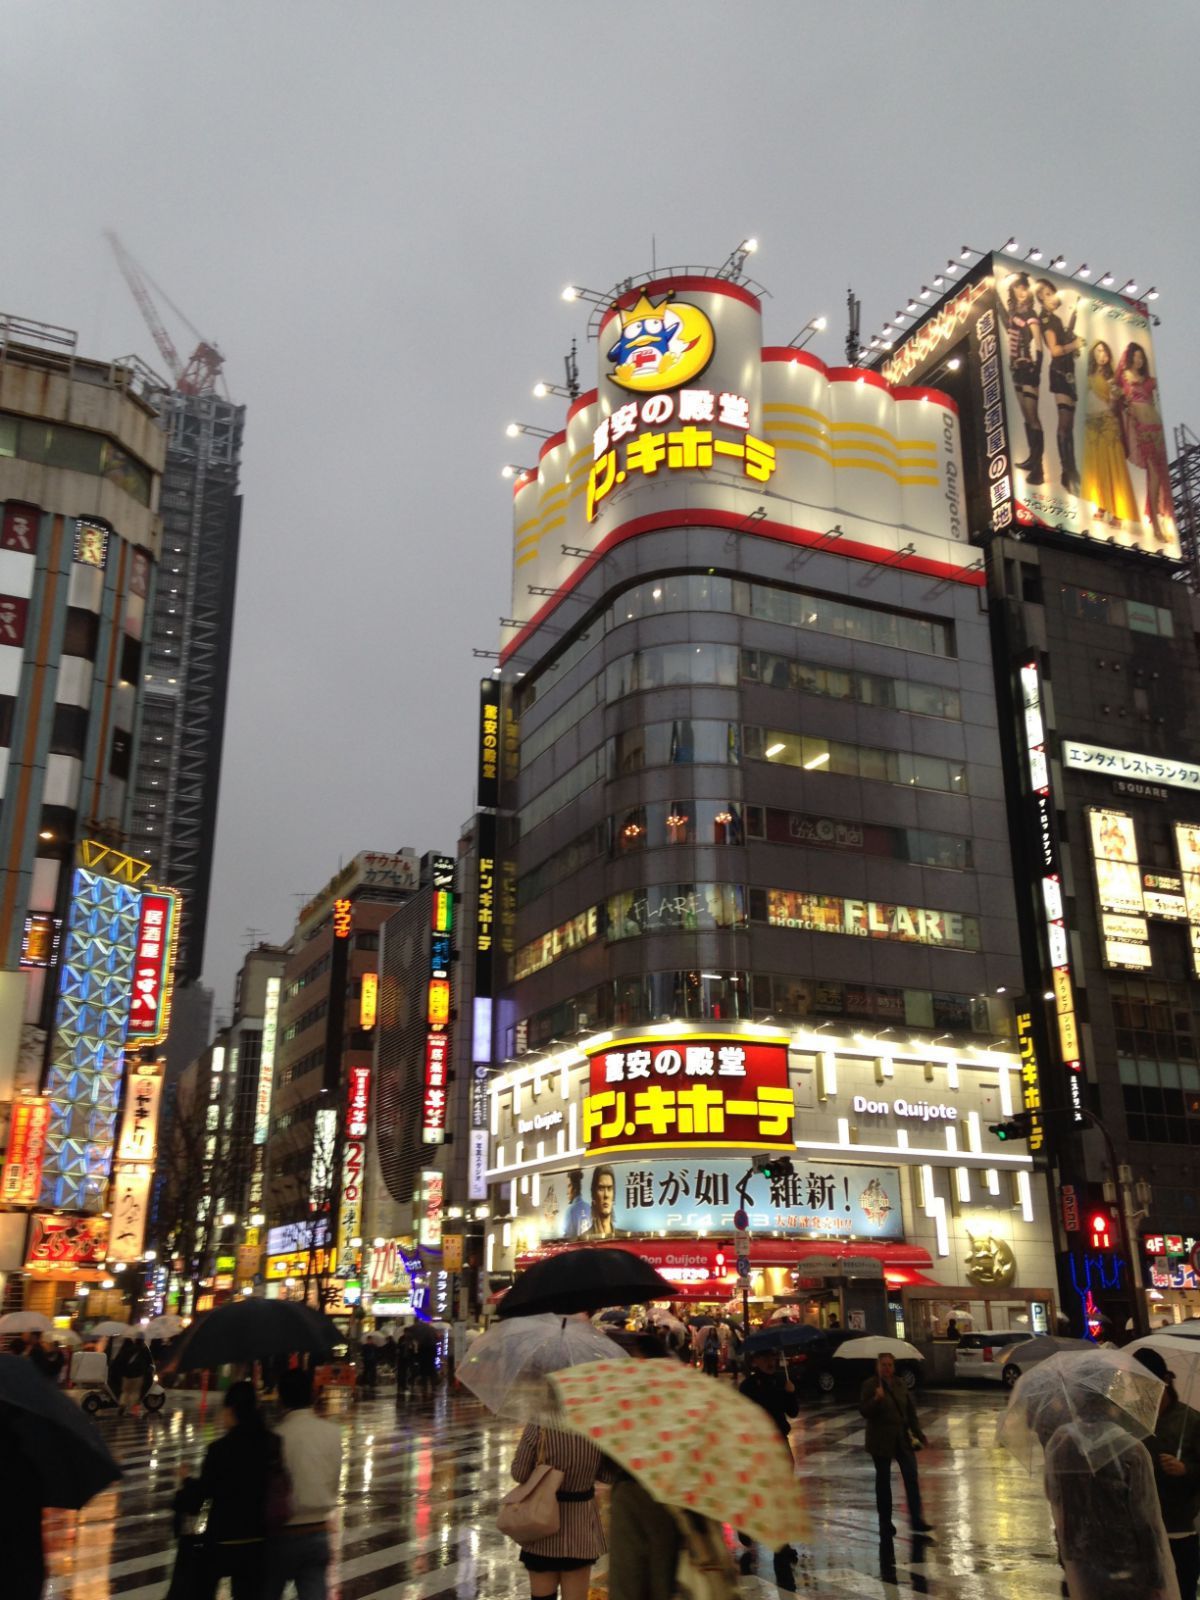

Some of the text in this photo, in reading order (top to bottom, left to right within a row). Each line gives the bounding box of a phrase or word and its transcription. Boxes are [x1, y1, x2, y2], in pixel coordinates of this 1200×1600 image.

[942, 412, 961, 539] Don Quijote
[1117, 782, 1168, 798] SQUARE
[364, 868, 417, 886] カプセル
[634, 893, 705, 921] FLARE
[843, 899, 964, 942] FLARE
[541, 906, 598, 962] FLARE
[768, 916, 815, 930] PHOTO
[604, 1046, 747, 1083] 驚安の殿堂
[853, 1095, 958, 1122] Don Quijote
[344, 1143, 363, 1201] 270
[666, 1213, 769, 1226] PS4 P3
[665, 1255, 708, 1267] Quijote
[436, 1271, 448, 1313] カラオケ
[1034, 1304, 1043, 1316] P
